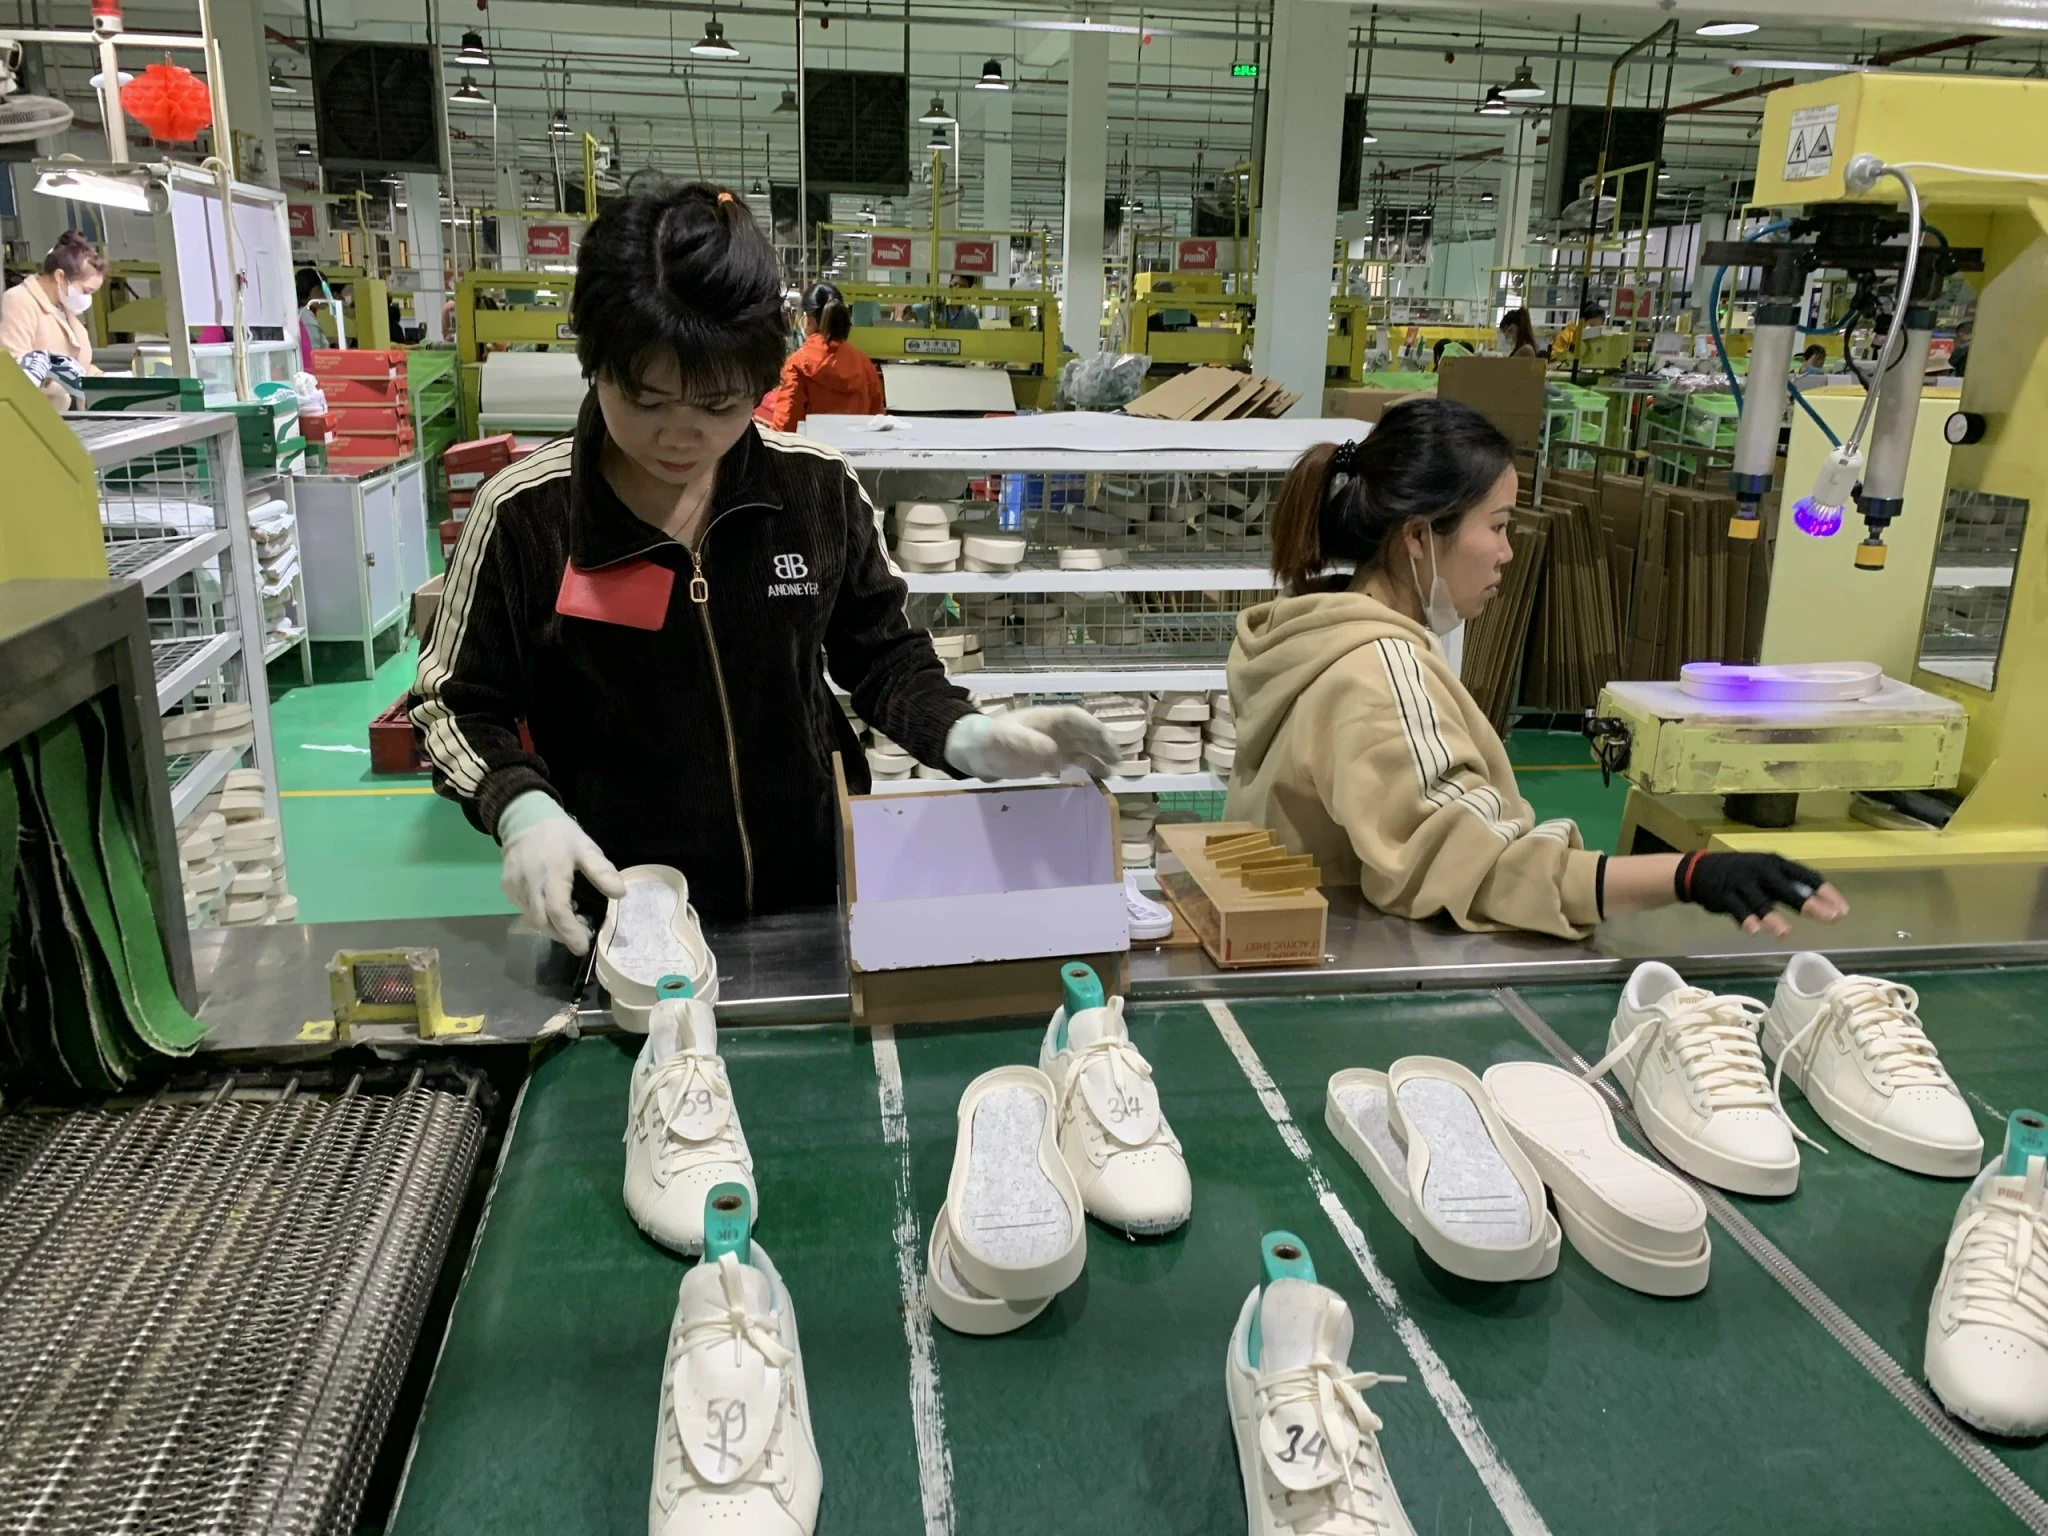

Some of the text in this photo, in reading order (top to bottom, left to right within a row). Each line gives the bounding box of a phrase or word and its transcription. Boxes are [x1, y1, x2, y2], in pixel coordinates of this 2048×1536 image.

[877, 250, 900, 260] PUMA
[960, 255, 983, 265] PUMA
[1184, 253, 1206, 263] PUMA
[682, 1089, 714, 1118] 59
[1107, 1096, 1145, 1123] 34
[1275, 1424, 1328, 1471] 34
